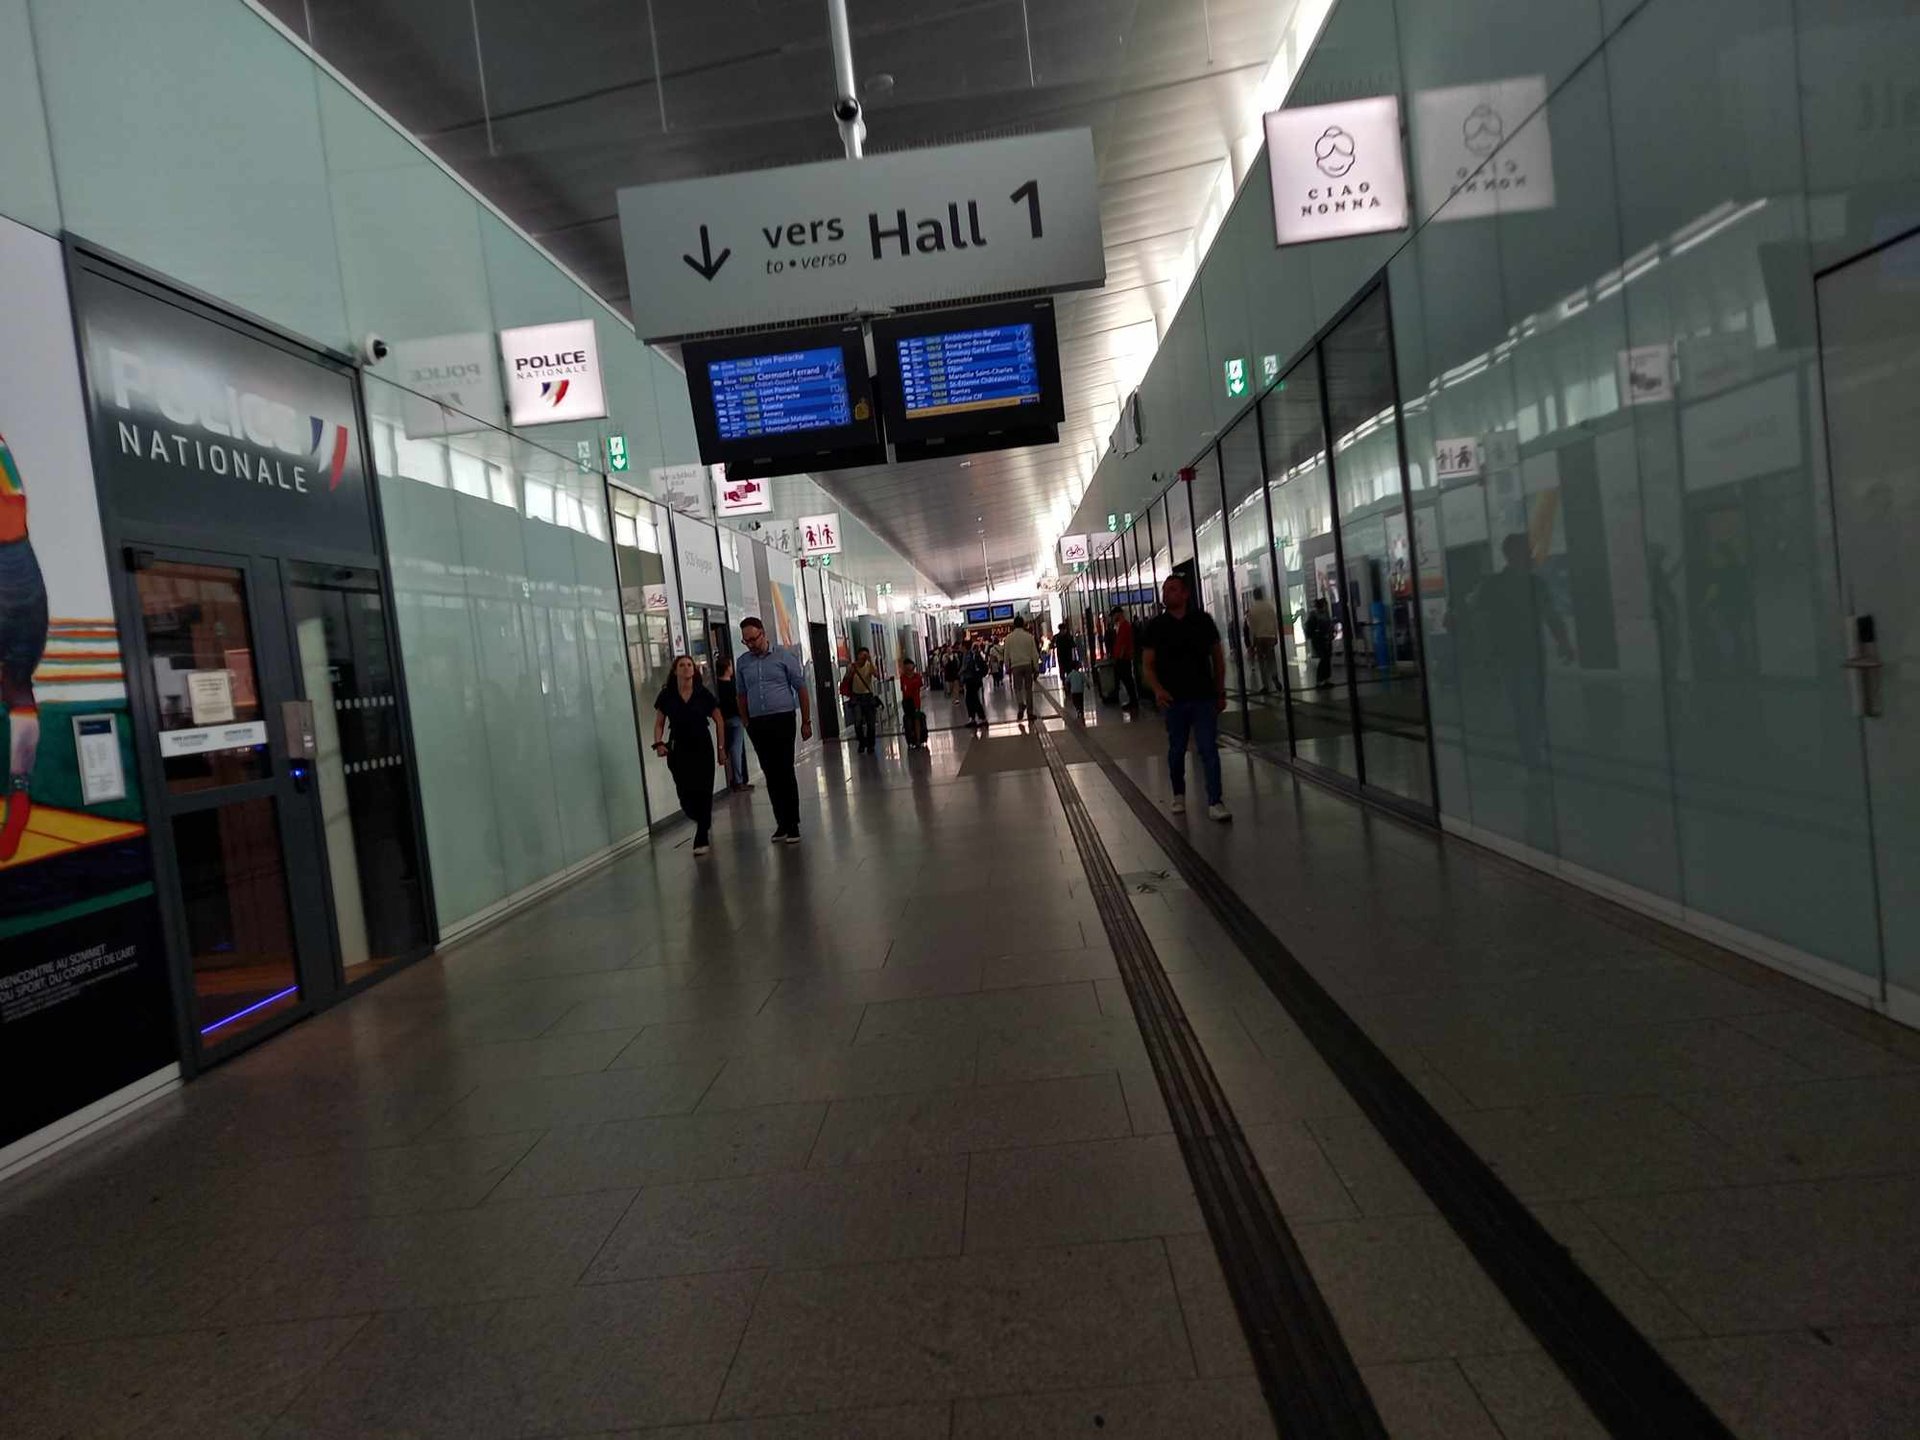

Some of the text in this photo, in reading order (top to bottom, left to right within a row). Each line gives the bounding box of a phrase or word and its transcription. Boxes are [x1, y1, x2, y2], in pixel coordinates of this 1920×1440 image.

[1308, 182, 1370, 200] CIAO
[1301, 196, 1380, 217] NONNA
[763, 179, 1044, 260] vers Hall 1
[766, 251, 847, 275] to verso
[515, 350, 586, 371] POLICE
[516, 364, 588, 379] NATIONALE
[756, 366, 819, 381] Clermont-Ferrand
[118, 420, 309, 493] NATIONALE
